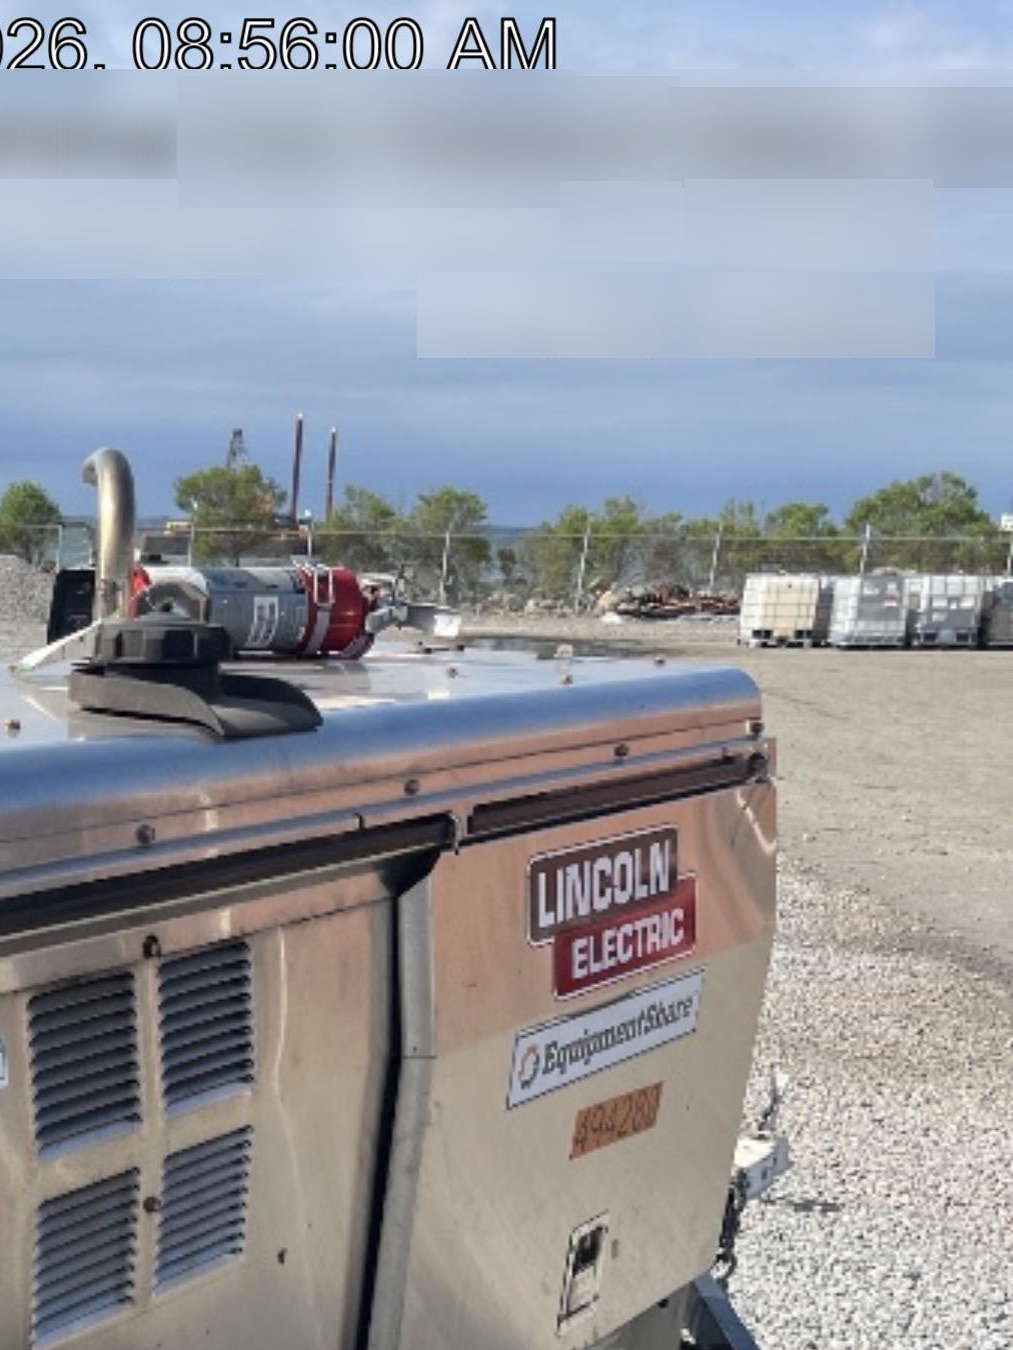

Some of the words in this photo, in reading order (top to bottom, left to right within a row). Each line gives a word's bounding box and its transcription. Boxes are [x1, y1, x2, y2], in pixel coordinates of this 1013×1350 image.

[538, 840, 670, 929] LINCOLN
[572, 908, 685, 979] ELECTRIC
[542, 996, 694, 1075] EquipmentShare
